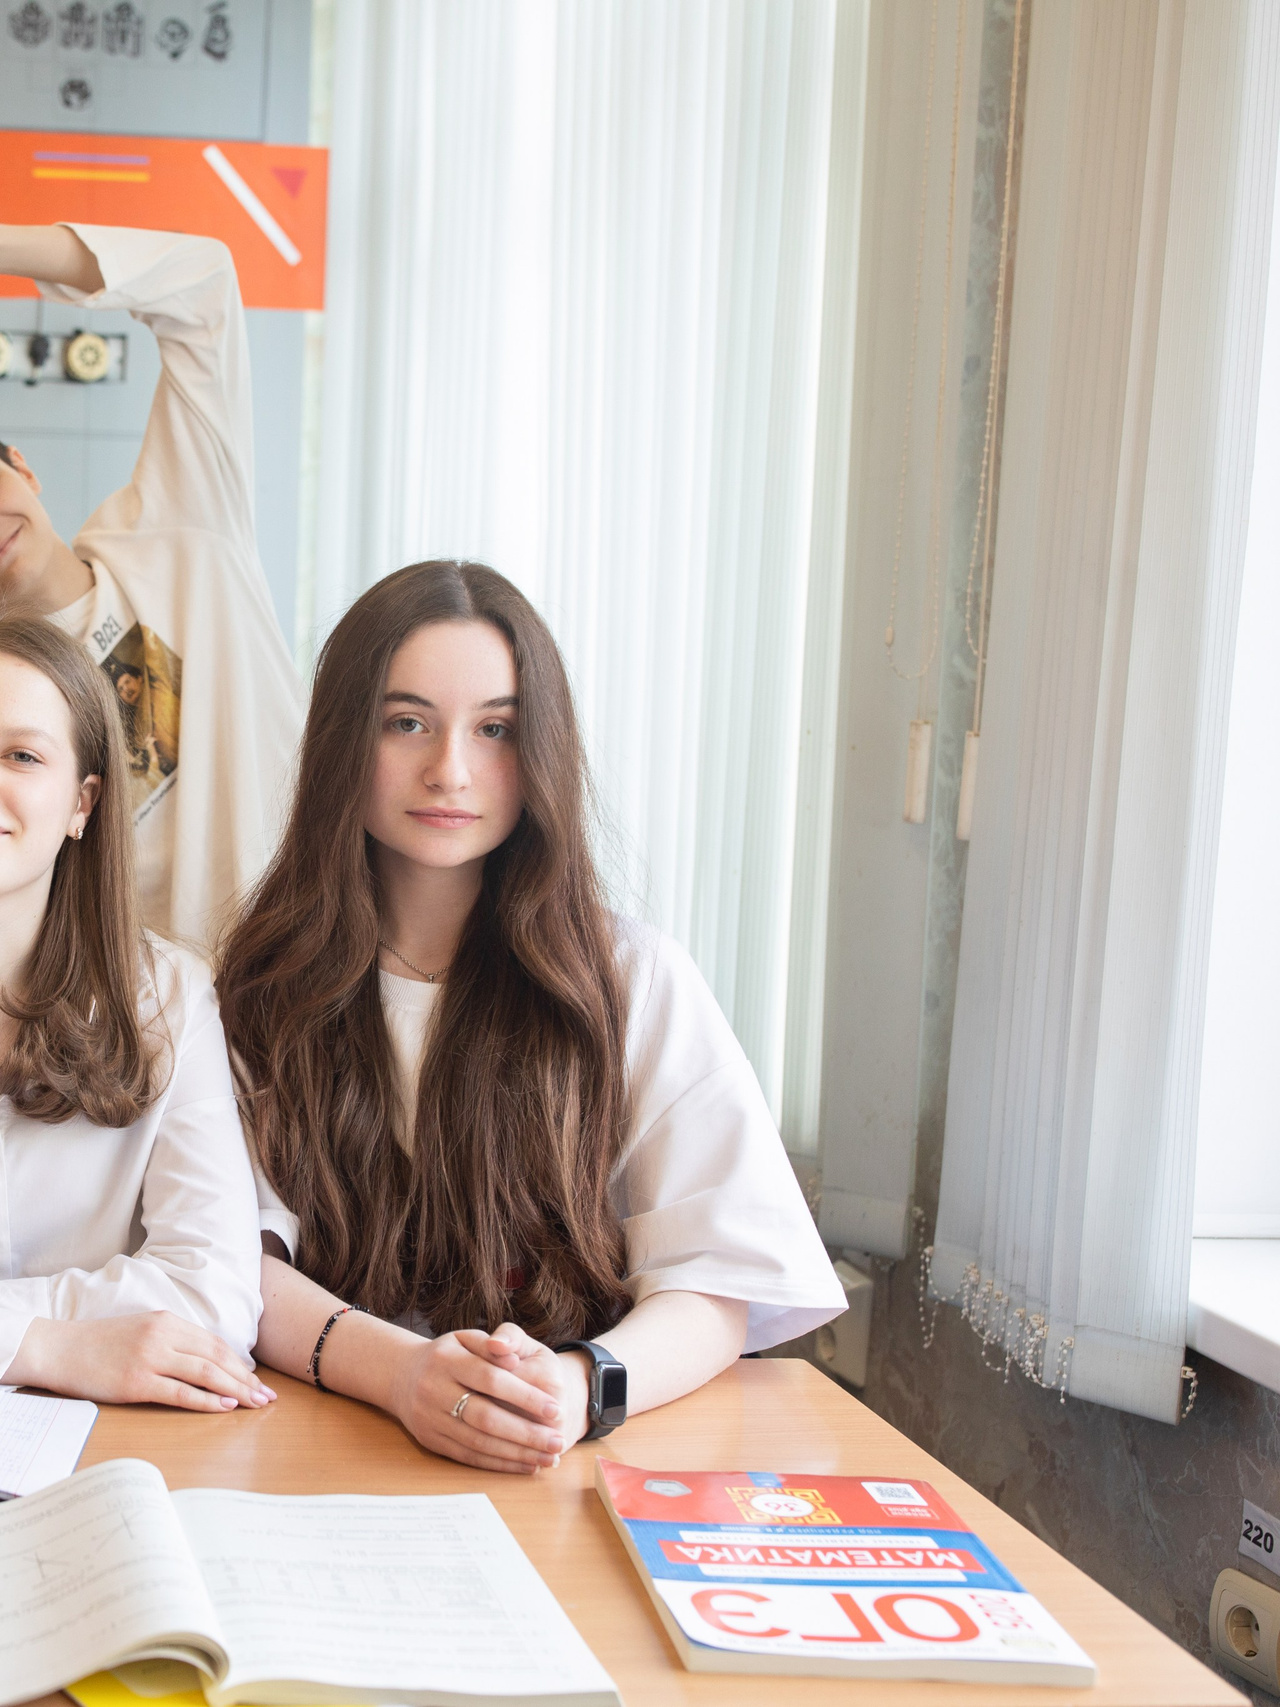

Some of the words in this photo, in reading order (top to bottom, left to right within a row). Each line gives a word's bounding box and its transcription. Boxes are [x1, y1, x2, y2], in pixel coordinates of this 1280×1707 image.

[1243, 1519, 1274, 1553] 220
[674, 1546, 965, 1567] МАТЕМАТИКА
[690, 1589, 980, 1643] ОГЭ
